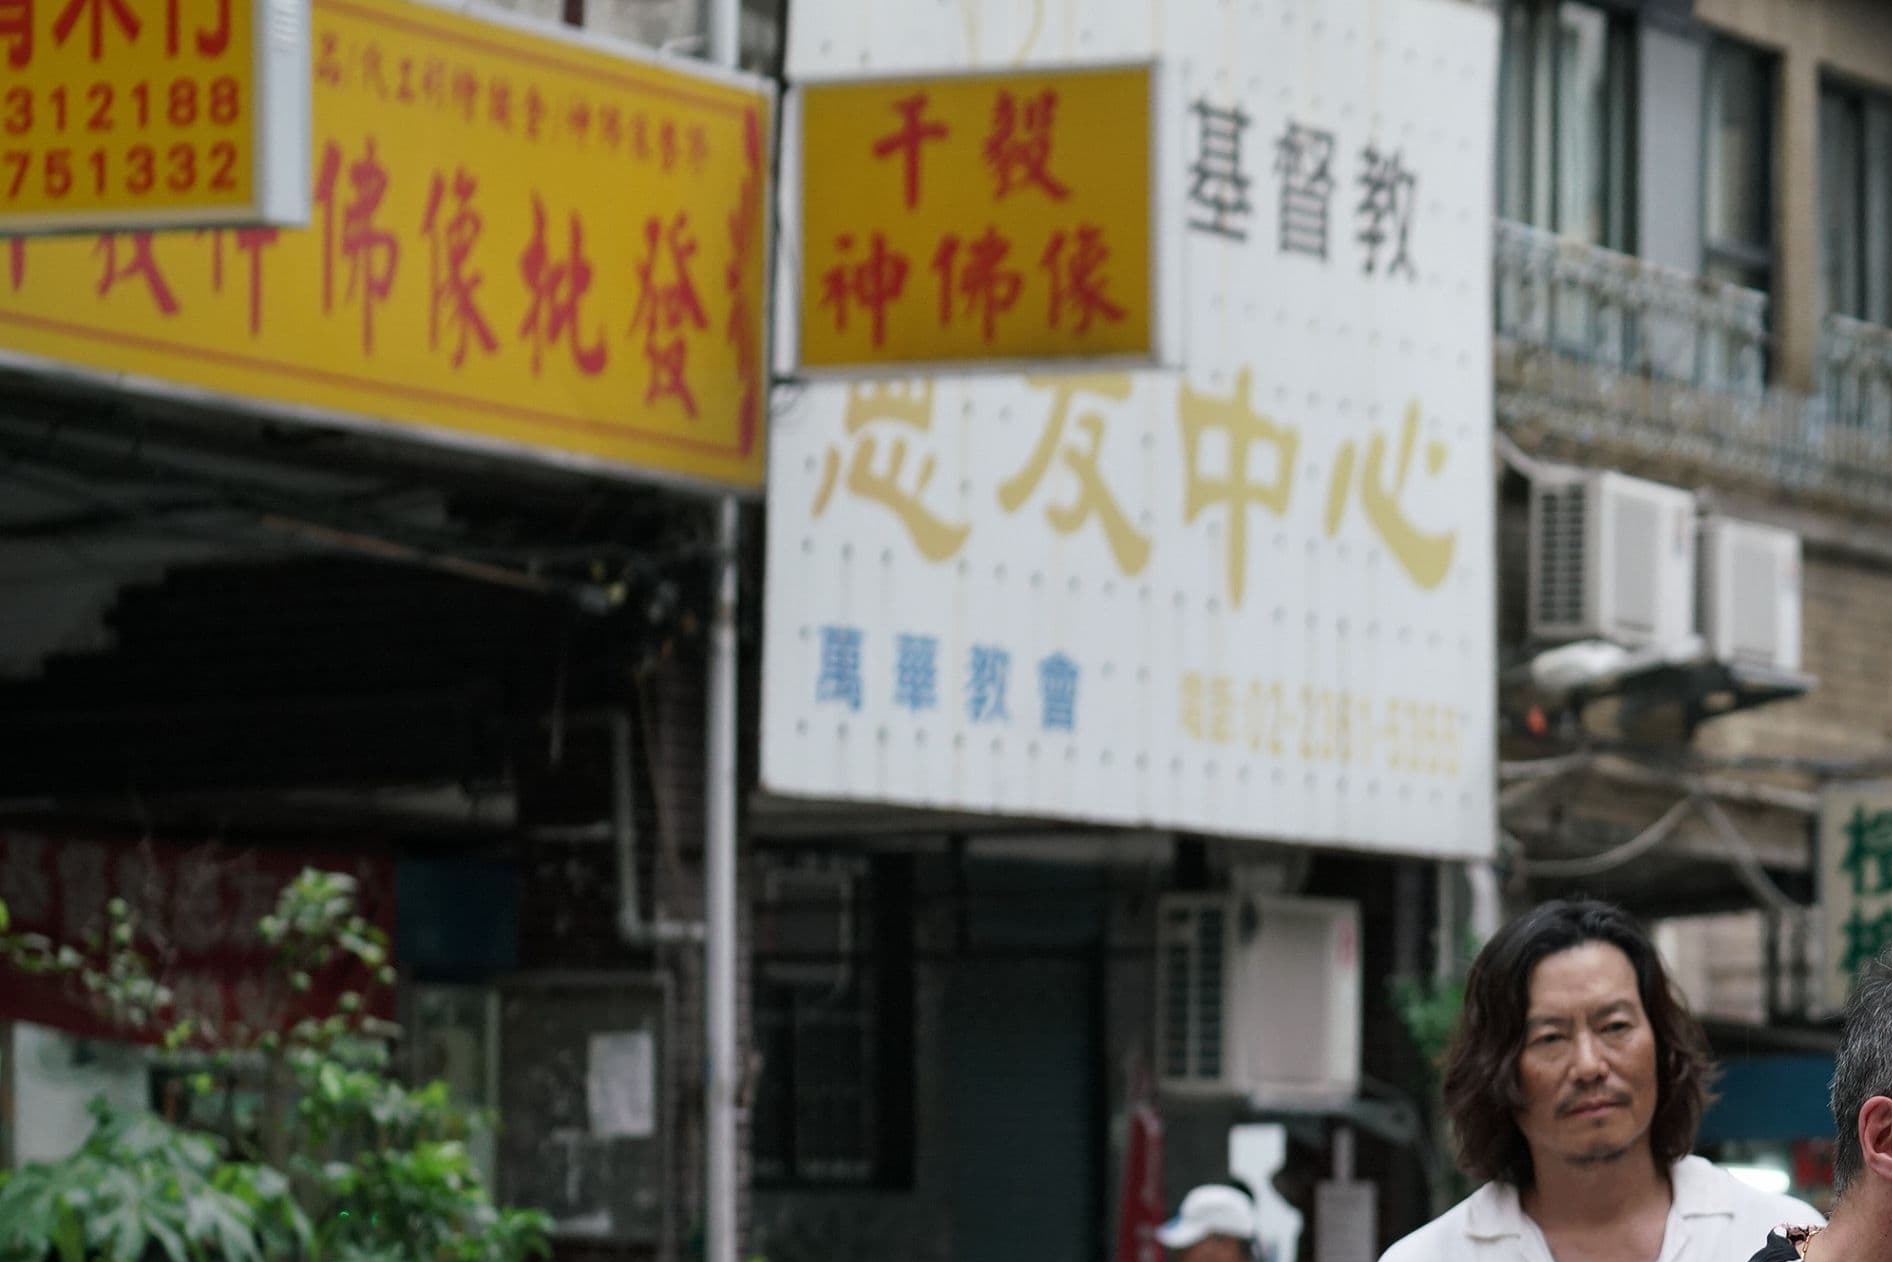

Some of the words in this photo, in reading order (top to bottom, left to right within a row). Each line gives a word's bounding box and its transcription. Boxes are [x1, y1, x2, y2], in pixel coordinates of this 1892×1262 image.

[1188, 97, 1419, 282] 基督教
[821, 222, 1129, 352] 神佛像
[815, 625, 1083, 734] 萬華教會
